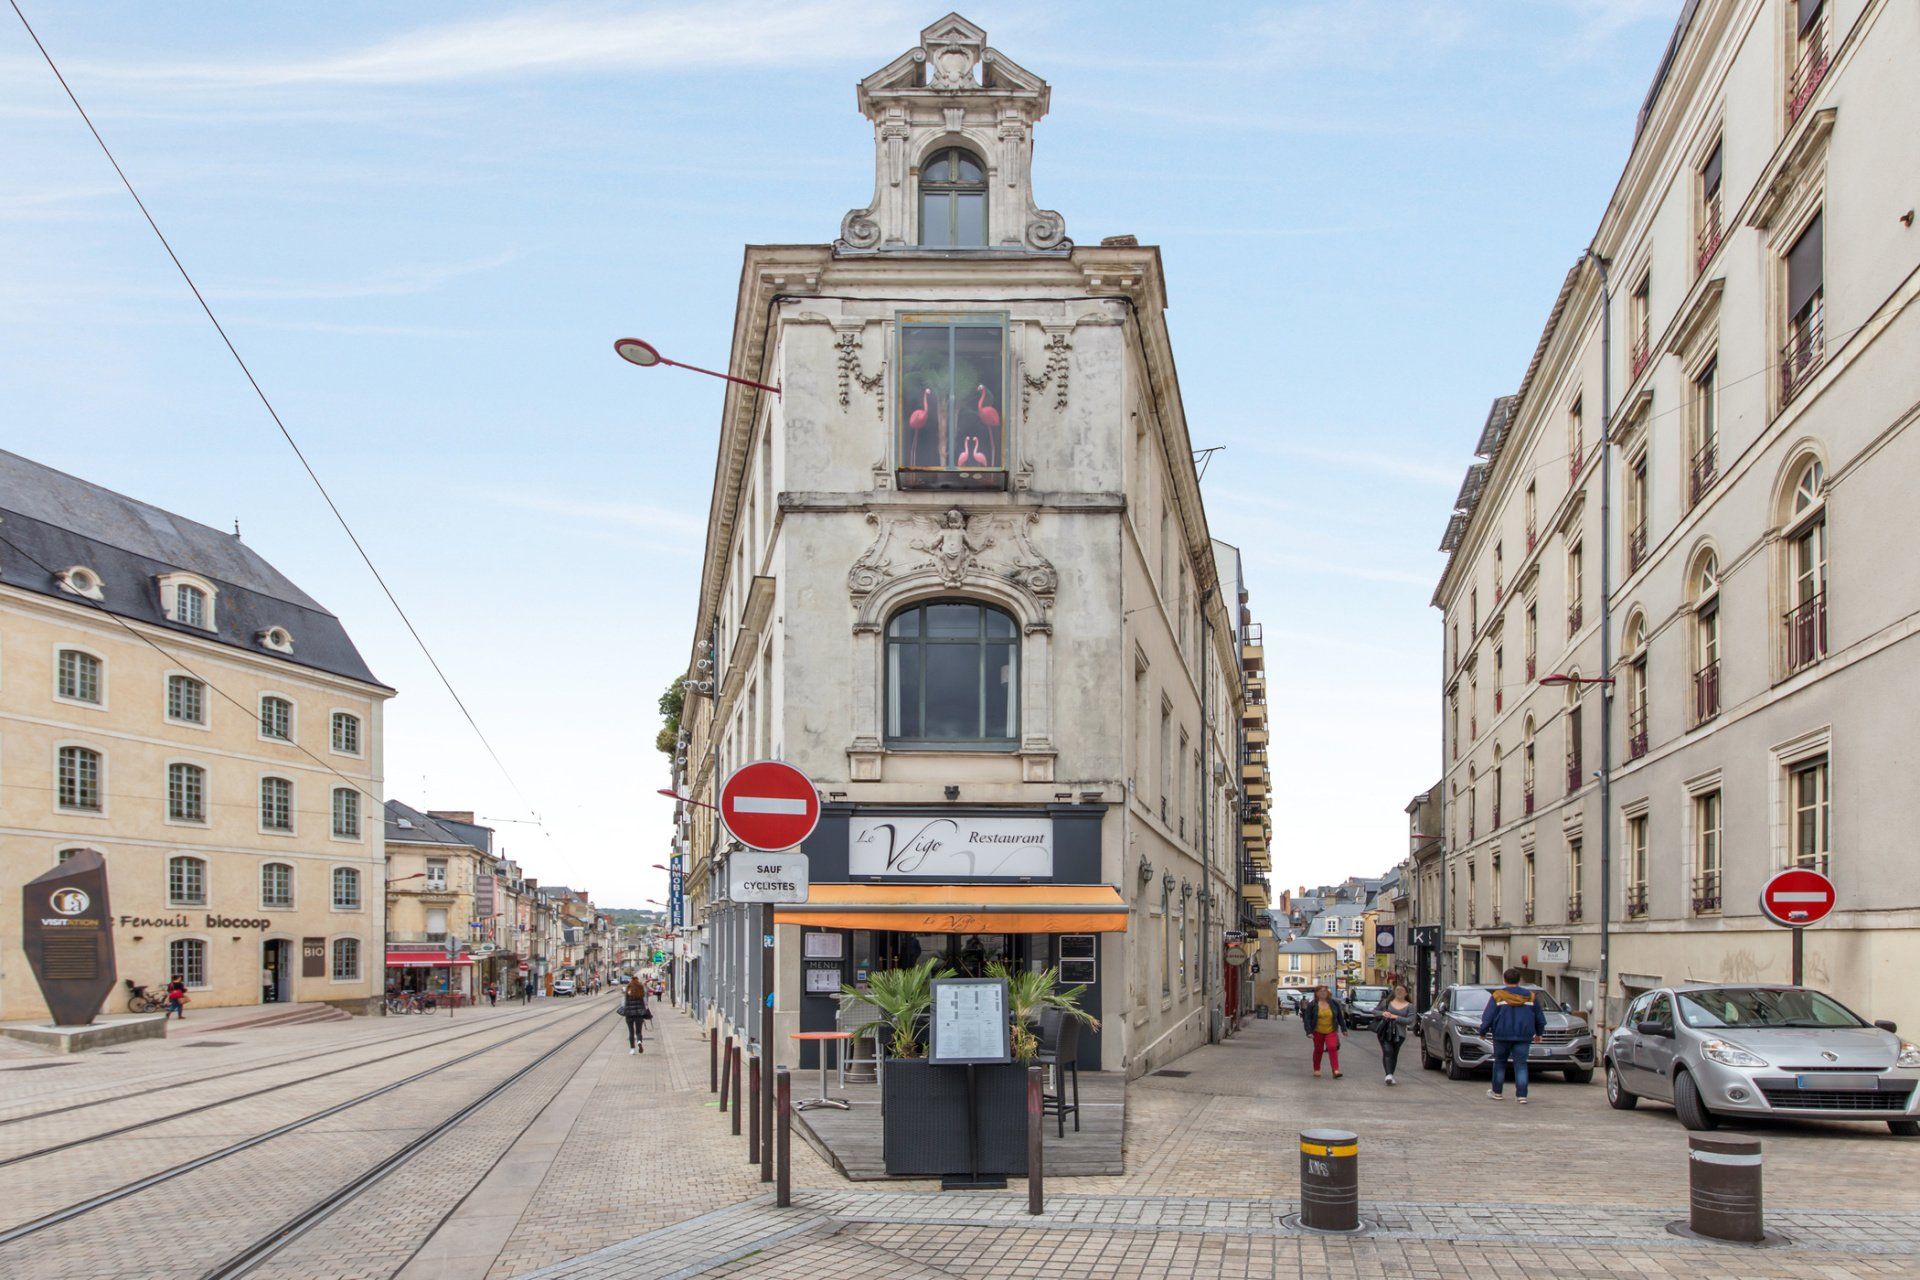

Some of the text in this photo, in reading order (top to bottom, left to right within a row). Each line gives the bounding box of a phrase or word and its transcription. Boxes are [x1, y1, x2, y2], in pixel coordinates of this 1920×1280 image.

[856, 818, 1046, 873] Le Vigo Restaurant
[757, 865, 782, 874] SAUF
[672, 857, 681, 925] IMMOBILIER
[743, 881, 796, 891] CYCLISTES
[41, 918, 99, 926] VISITATION
[120, 914, 189, 928] Fenouil
[206, 914, 271, 931] biocoop
[304, 947, 324, 957] BIO
[810, 961, 837, 969] MENU
